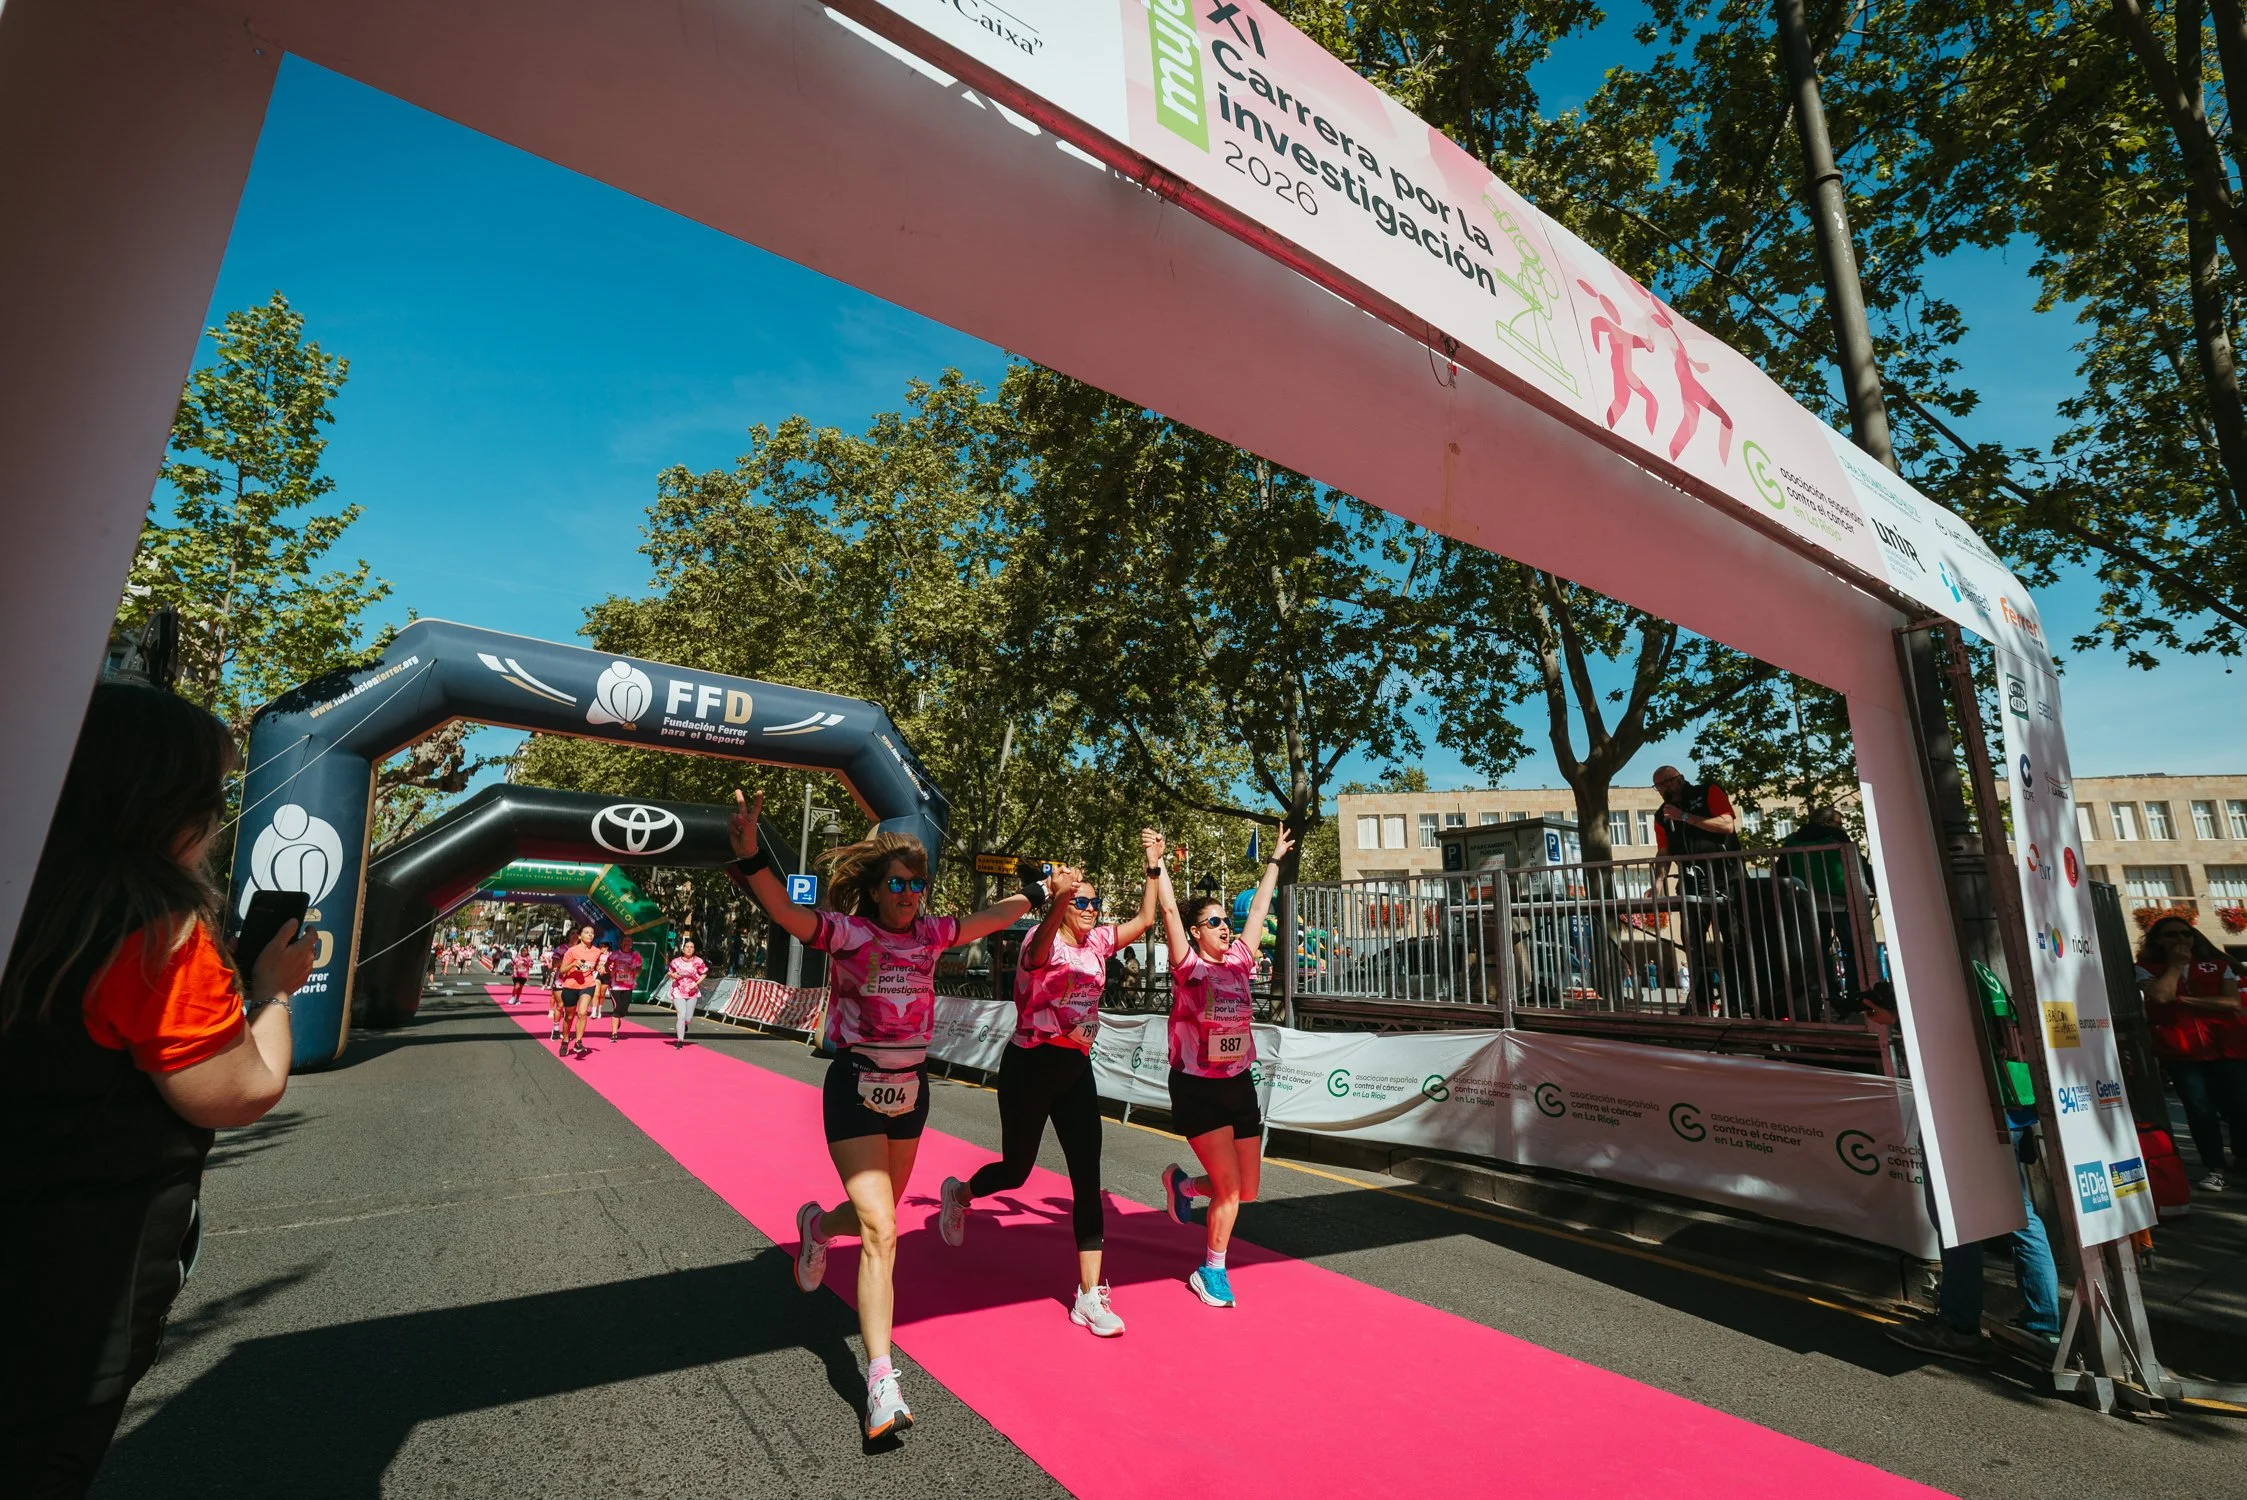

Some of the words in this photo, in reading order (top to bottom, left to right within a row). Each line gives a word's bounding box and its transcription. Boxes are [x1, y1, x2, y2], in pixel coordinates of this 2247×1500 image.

[1206, 0, 1266, 59] XI
[1140, 0, 1201, 126] muje
[1211, 39, 1382, 179] Carrera
[1390, 166, 1450, 224] por
[1457, 207, 1494, 256] la
[1224, 140, 1318, 216] 2026
[1217, 81, 1497, 297] investigación
[1780, 467, 1828, 503] asociación
[1827, 497, 1865, 527] española
[1786, 486, 1817, 511] contra
[1817, 503, 1827, 518] el
[1826, 510, 1855, 534] cáncer
[2000, 596, 2038, 638] ferrer
[665, 680, 753, 724] FFD
[661, 727, 686, 737] para
[690, 731, 701, 739] el
[705, 733, 745, 746] Deporte
[663, 717, 716, 732] Fundación
[717, 724, 749, 737] Ferrer
[1549, 835, 1556, 850] P
[792, 878, 811, 900] P
[599, 885, 636, 926] PITILLOS
[880, 962, 915, 972] Carrera
[307, 972, 329, 982] rrer
[879, 975, 896, 984] por
[896, 975, 905, 983] la
[1214, 1006, 1227, 1014] por
[2080, 1019, 2097, 1032] europa
[1220, 1037, 1241, 1053] 887
[1296, 1068, 1324, 1077] español
[1355, 1074, 1388, 1082] asociación
[1389, 1076, 1418, 1085] española
[1354, 1082, 1374, 1090] contra
[1382, 1083, 1404, 1092] cáncer
[1453, 1076, 1492, 1087] asociación
[1494, 1079, 1527, 1091] española
[1454, 1085, 1478, 1094] contra
[1488, 1088, 1510, 1099] cáncer
[2095, 1079, 2121, 1099] Gente
[871, 1087, 906, 1105] 804
[1371, 1091, 1387, 1100] Rioja
[1465, 1096, 1475, 1104] La
[1476, 1097, 1495, 1107] Rioja
[1570, 1090, 1616, 1104] asociación
[1617, 1098, 1660, 1111] española
[2058, 1086, 2080, 1114] 941
[1571, 1101, 1599, 1111] contra
[1601, 1104, 1610, 1113] el
[1610, 1106, 1642, 1118] cáncer
[1585, 1112, 1596, 1121] La
[1597, 1115, 1619, 1127] Rioja
[1710, 1112, 1768, 1130] asociación
[1770, 1122, 1824, 1138] española
[1713, 1124, 1748, 1138] contra
[1750, 1129, 1760, 1139] el
[1763, 1131, 1801, 1146] cáncer
[1714, 1136, 1728, 1145] en
[1730, 1137, 1743, 1148] La
[1746, 1140, 1773, 1155] Rioja
[2078, 1171, 2091, 1198] El
[2088, 1171, 2108, 1195] Día
